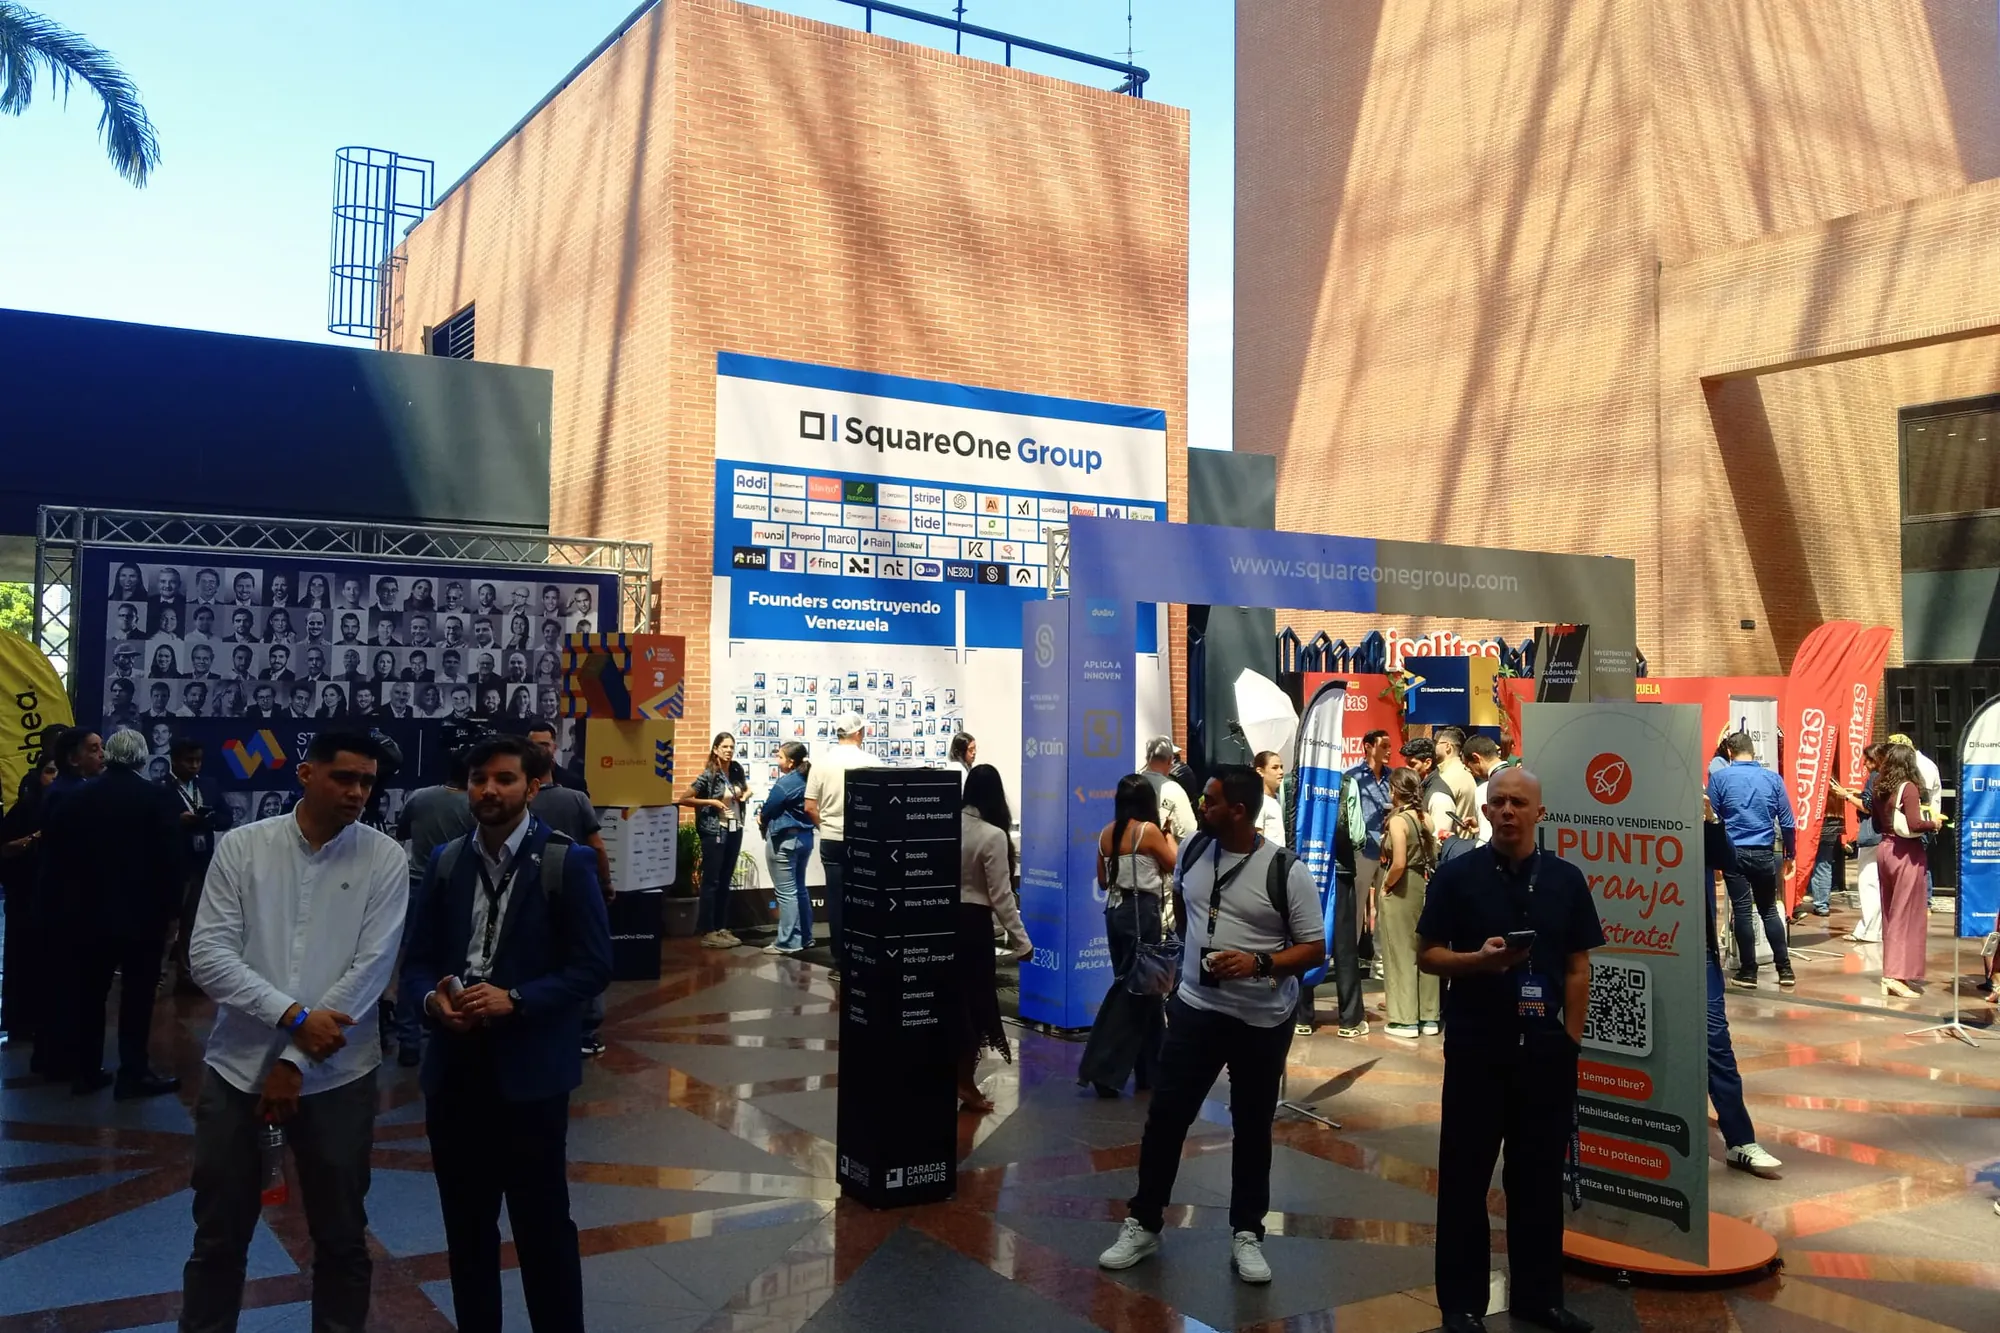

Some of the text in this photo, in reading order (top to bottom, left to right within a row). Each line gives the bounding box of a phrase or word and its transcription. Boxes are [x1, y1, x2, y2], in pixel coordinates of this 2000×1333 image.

[845, 416, 1102, 474] SquareOne Group
[736, 474, 767, 490] Addi
[914, 492, 941, 505] stripe
[736, 503, 767, 512] AUGUSTUS
[914, 516, 940, 529] tide
[791, 532, 821, 543] Proprio
[827, 534, 856, 545] marco
[870, 538, 891, 548] Rain
[818, 558, 838, 569] fina
[1229, 556, 1518, 593] www.squareonegroup.com
[749, 591, 941, 615] Founders construyendo
[805, 615, 889, 632] Venezuela
[1084, 660, 1121, 669] APLICA A
[1084, 672, 1121, 680] INNOVEN
[1636, 683, 1661, 695] ZUELA
[1039, 737, 1063, 756] rain
[1542, 812, 1683, 832] GANA DINERO VENDIENDO
[1970, 820, 1982, 828] La
[1971, 831, 2000, 840] genera
[1557, 828, 1684, 868] PUNTO
[1972, 839, 1982, 848] de
[905, 869, 933, 877] Auditorio
[1587, 866, 1685, 920] ranja
[904, 899, 921, 907] Wave
[923, 898, 937, 906] Tech
[1599, 918, 1680, 950] strate!
[1079, 948, 1109, 958] FOUND
[1075, 960, 1105, 971] APLICA
[902, 1017, 938, 1027] Corporativo
[1583, 1071, 1615, 1086] tiempo
[1617, 1076, 1645, 1091] libre?
[1578, 1104, 1681, 1133] Habilidades en ventas?
[1599, 1146, 1609, 1157] tu
[1611, 1151, 1662, 1169] potencial!
[907, 1161, 946, 1175] CARACAS
[907, 1171, 946, 1186] CAMPUS
[1563, 1172, 1683, 1209] Metiza en tu tiempo libre!
